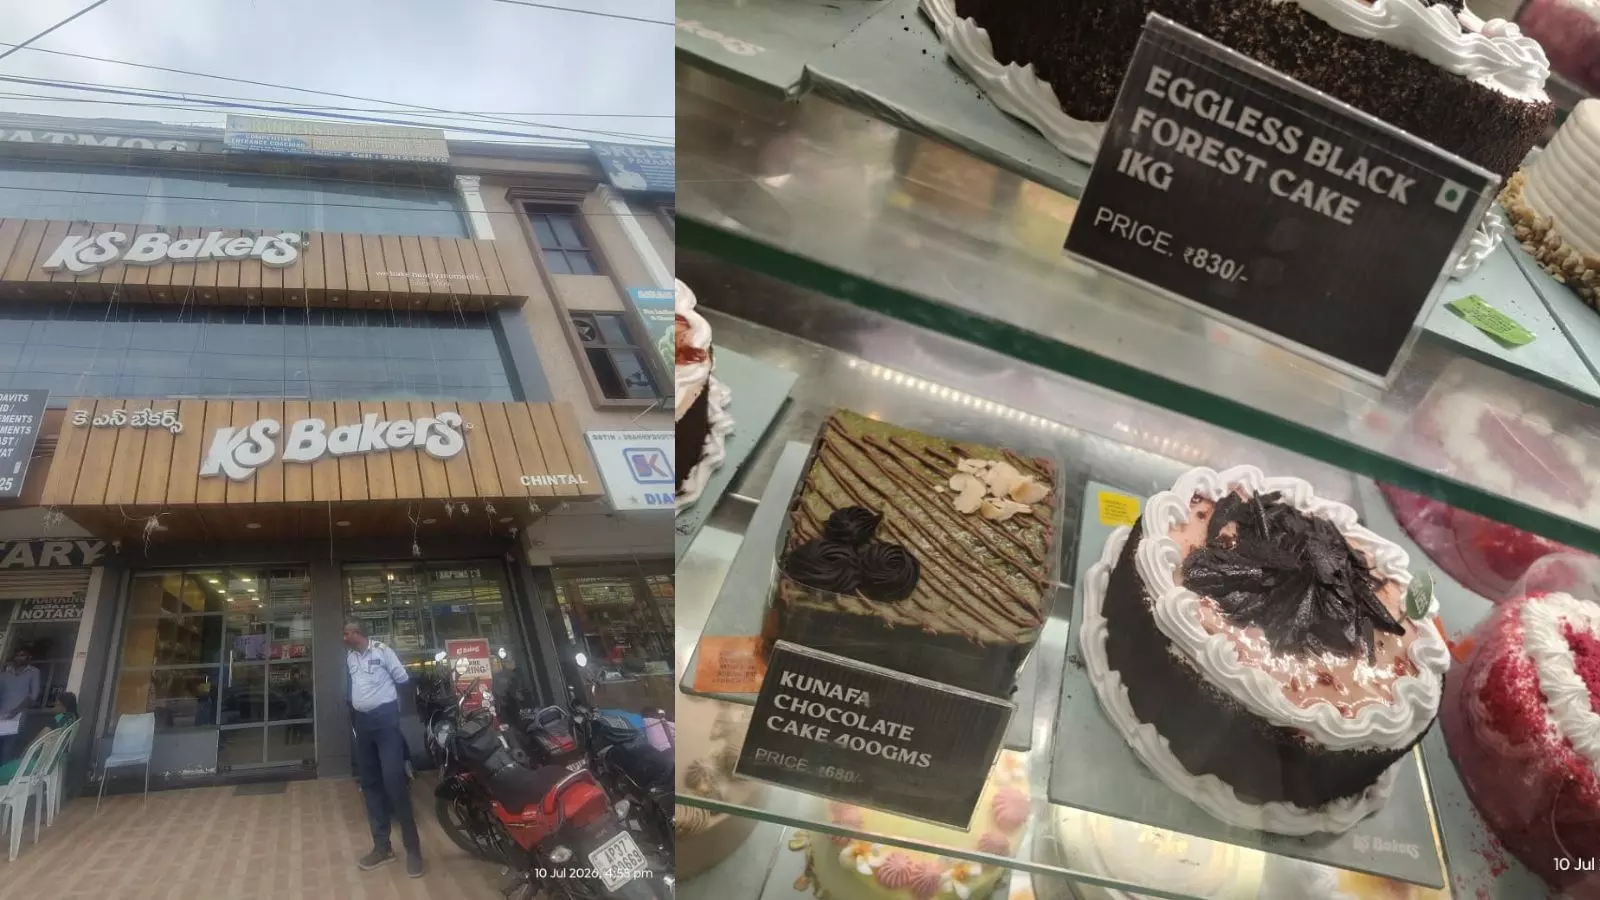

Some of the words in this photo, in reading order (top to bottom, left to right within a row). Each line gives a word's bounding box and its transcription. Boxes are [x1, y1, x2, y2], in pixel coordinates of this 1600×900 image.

[1144, 65, 1304, 155] EGGLESS
[1303, 135, 1417, 205] BLACK
[1116, 147, 1175, 192] 1KG
[1129, 106, 1268, 184] FOREST
[1269, 168, 1363, 226] CAKE
[42, 231, 126, 275] KS
[123, 231, 301, 268] Bakers
[1093, 206, 1173, 257] PRICE.
[1183, 246, 1248, 282] ₹830/-
[199, 418, 281, 482] KS
[282, 411, 464, 463] Bakers
[520, 473, 589, 486] CHINTAL
[644, 492, 674, 505] DIA
[0, 540, 106, 569] ARY
[21, 608, 84, 619] NOTARY
[779, 670, 871, 709] KUNAFA
[773, 693, 915, 742] CHOCOLATE
[766, 715, 831, 744] CAKE
[833, 732, 933, 768] 400GMS
[604, 839, 629, 864] AP37
